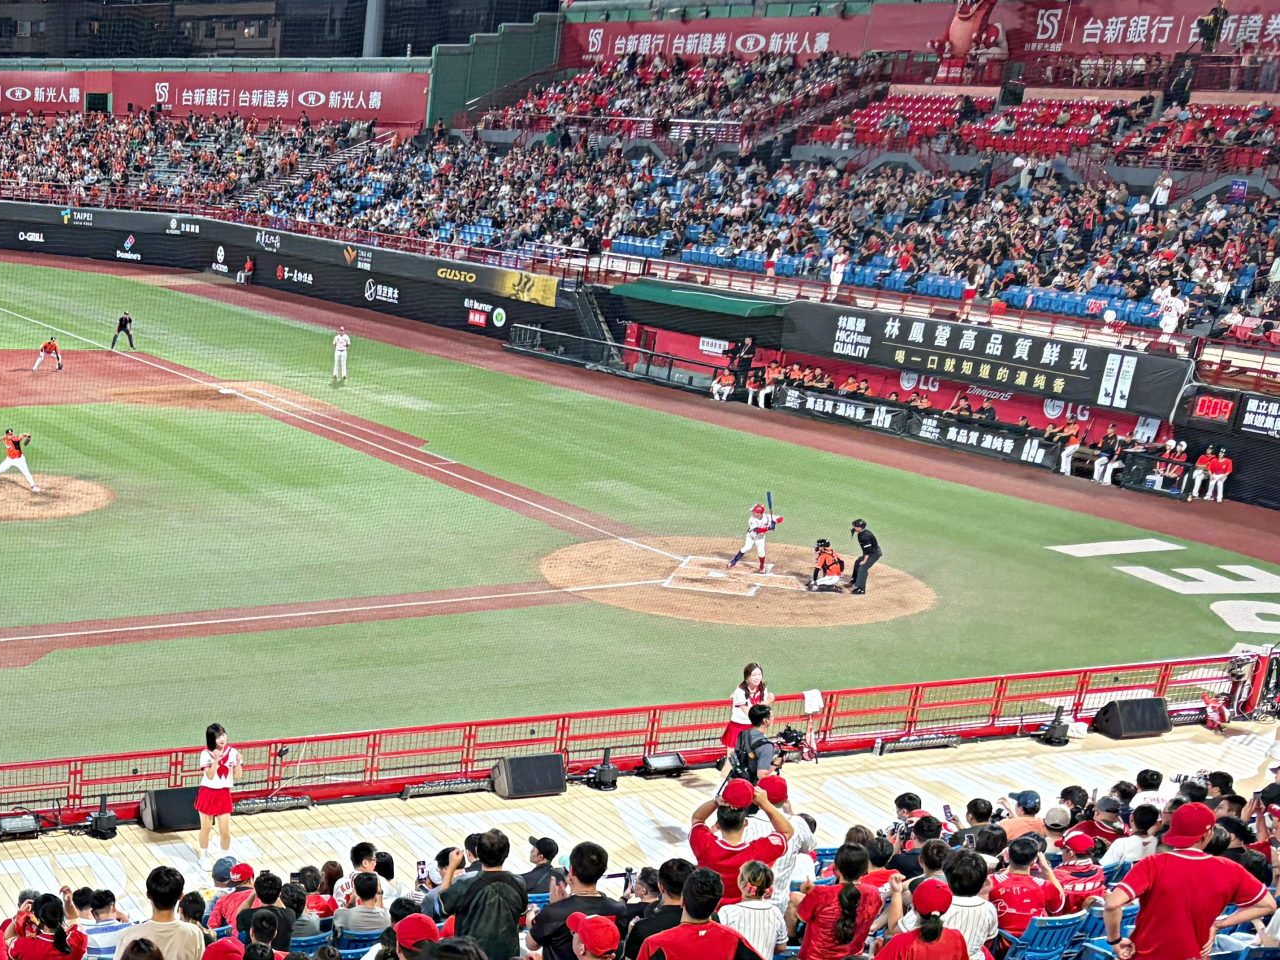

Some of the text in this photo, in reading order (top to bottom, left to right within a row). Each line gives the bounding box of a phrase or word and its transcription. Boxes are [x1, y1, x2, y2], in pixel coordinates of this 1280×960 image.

[1082, 15, 1174, 43] 台新銀行
[614, 34, 665, 55] 台新銀行
[672, 33, 727, 55] 台新證券
[769, 32, 829, 54] 新光人壽
[33, 87, 80, 104] 新光人壽
[182, 88, 230, 106] 台新銀行
[238, 89, 289, 107] 台新證券
[329, 91, 381, 109] 新光人壽
[73, 211, 93, 221] TAIPEI
[18, 231, 45, 242] O-GRILL
[436, 267, 476, 283] GUSTO
[834, 330, 858, 344] HIGH
[884, 317, 1088, 372] 林鳳營高品質鮮乳
[832, 341, 870, 359] QUALITY
[894, 349, 1065, 395] 喝一口就知道的濃純香
[919, 374, 940, 392] LG
[1065, 403, 1090, 421] LG
[1195, 396, 1234, 421] 0:04
